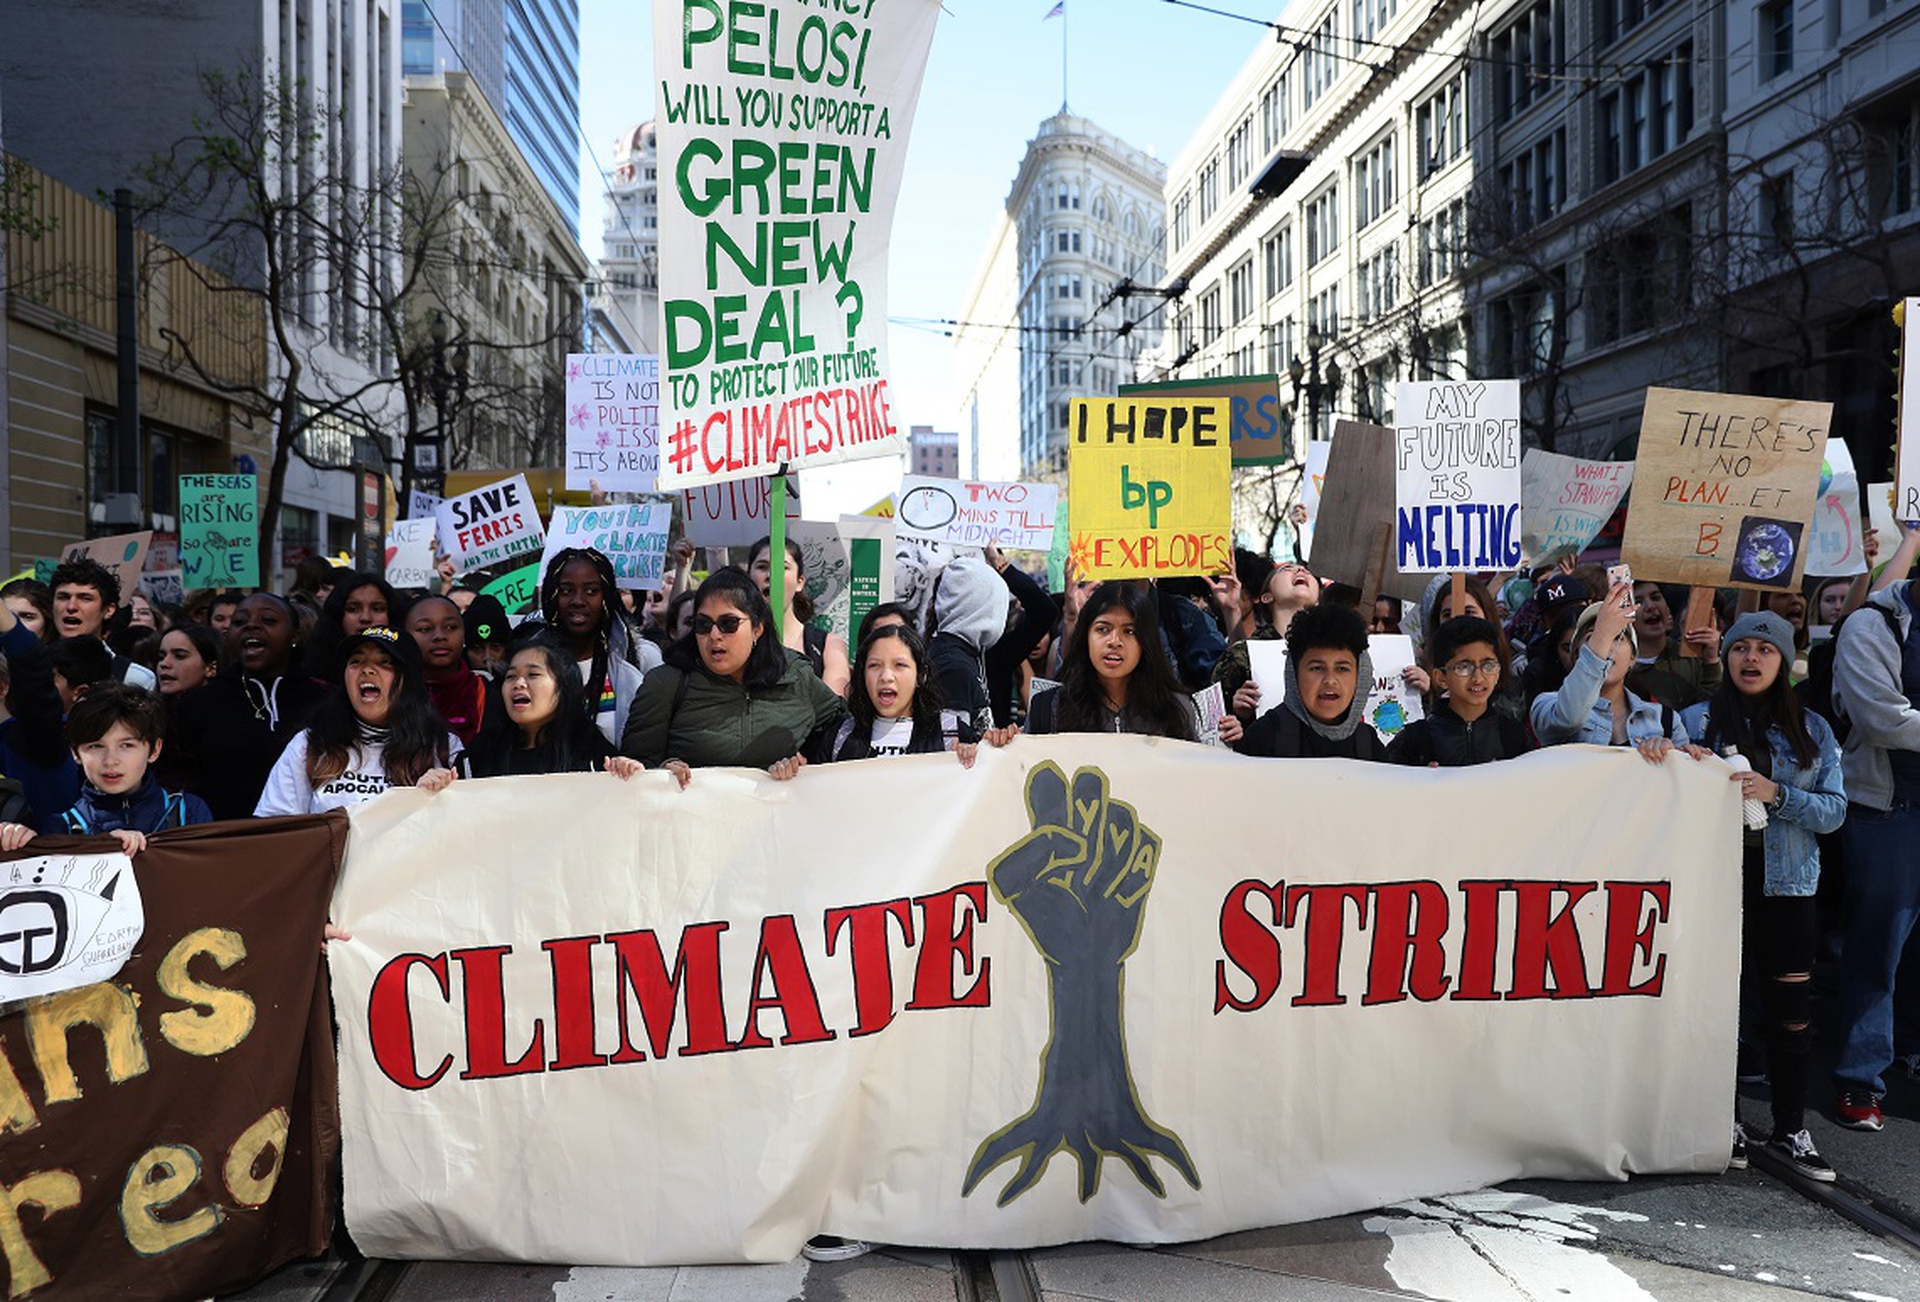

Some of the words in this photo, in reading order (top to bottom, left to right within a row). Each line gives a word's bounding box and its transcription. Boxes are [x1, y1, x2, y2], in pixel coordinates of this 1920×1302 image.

[662, 80, 730, 125] WILL
[736, 86, 783, 128] YOU
[788, 94, 875, 136] SUPPORT
[874, 107, 891, 139] A
[675, 138, 876, 217] GREEN
[705, 218, 856, 290] NEW
[582, 357, 659, 377] CLIMATE
[668, 373, 700, 410] TO
[710, 362, 789, 405] PROTECT
[793, 356, 819, 392] OUR
[823, 348, 880, 386] FUTURE
[591, 380, 616, 400] IS
[1425, 382, 1487, 420] MY
[668, 379, 897, 475] #CLIMATESTRIKE
[1077, 403, 1088, 443] I
[1106, 403, 1218, 447] HOPE
[1677, 410, 1823, 453] THERE'S
[1398, 418, 1519, 471] FUTURE
[181, 476, 216, 489] THE
[217, 476, 252, 490] SEAS
[1708, 454, 1752, 478] NO
[202, 494, 226, 504] are
[965, 484, 1028, 503] TWO
[1121, 464, 1174, 530] bp
[1429, 471, 1474, 502] IS
[181, 502, 254, 524] RISING
[452, 483, 521, 530] SAVE
[565, 504, 652, 535] YOUTH
[958, 507, 998, 523] MINS
[1006, 510, 1055, 529] TILL
[184, 539, 201, 550] so
[229, 537, 252, 548] are
[457, 512, 524, 552] FERRIS
[946, 525, 1042, 545] MIDNIGHT
[1399, 503, 1522, 569] MELTING
[1695, 522, 1723, 556] B
[463, 556, 481, 570] AND
[482, 548, 500, 561] THE
[1094, 533, 1229, 571] EXPLODES
[1213, 878, 1672, 1016] STRIKE
[367, 881, 992, 1091] CLIMATE
